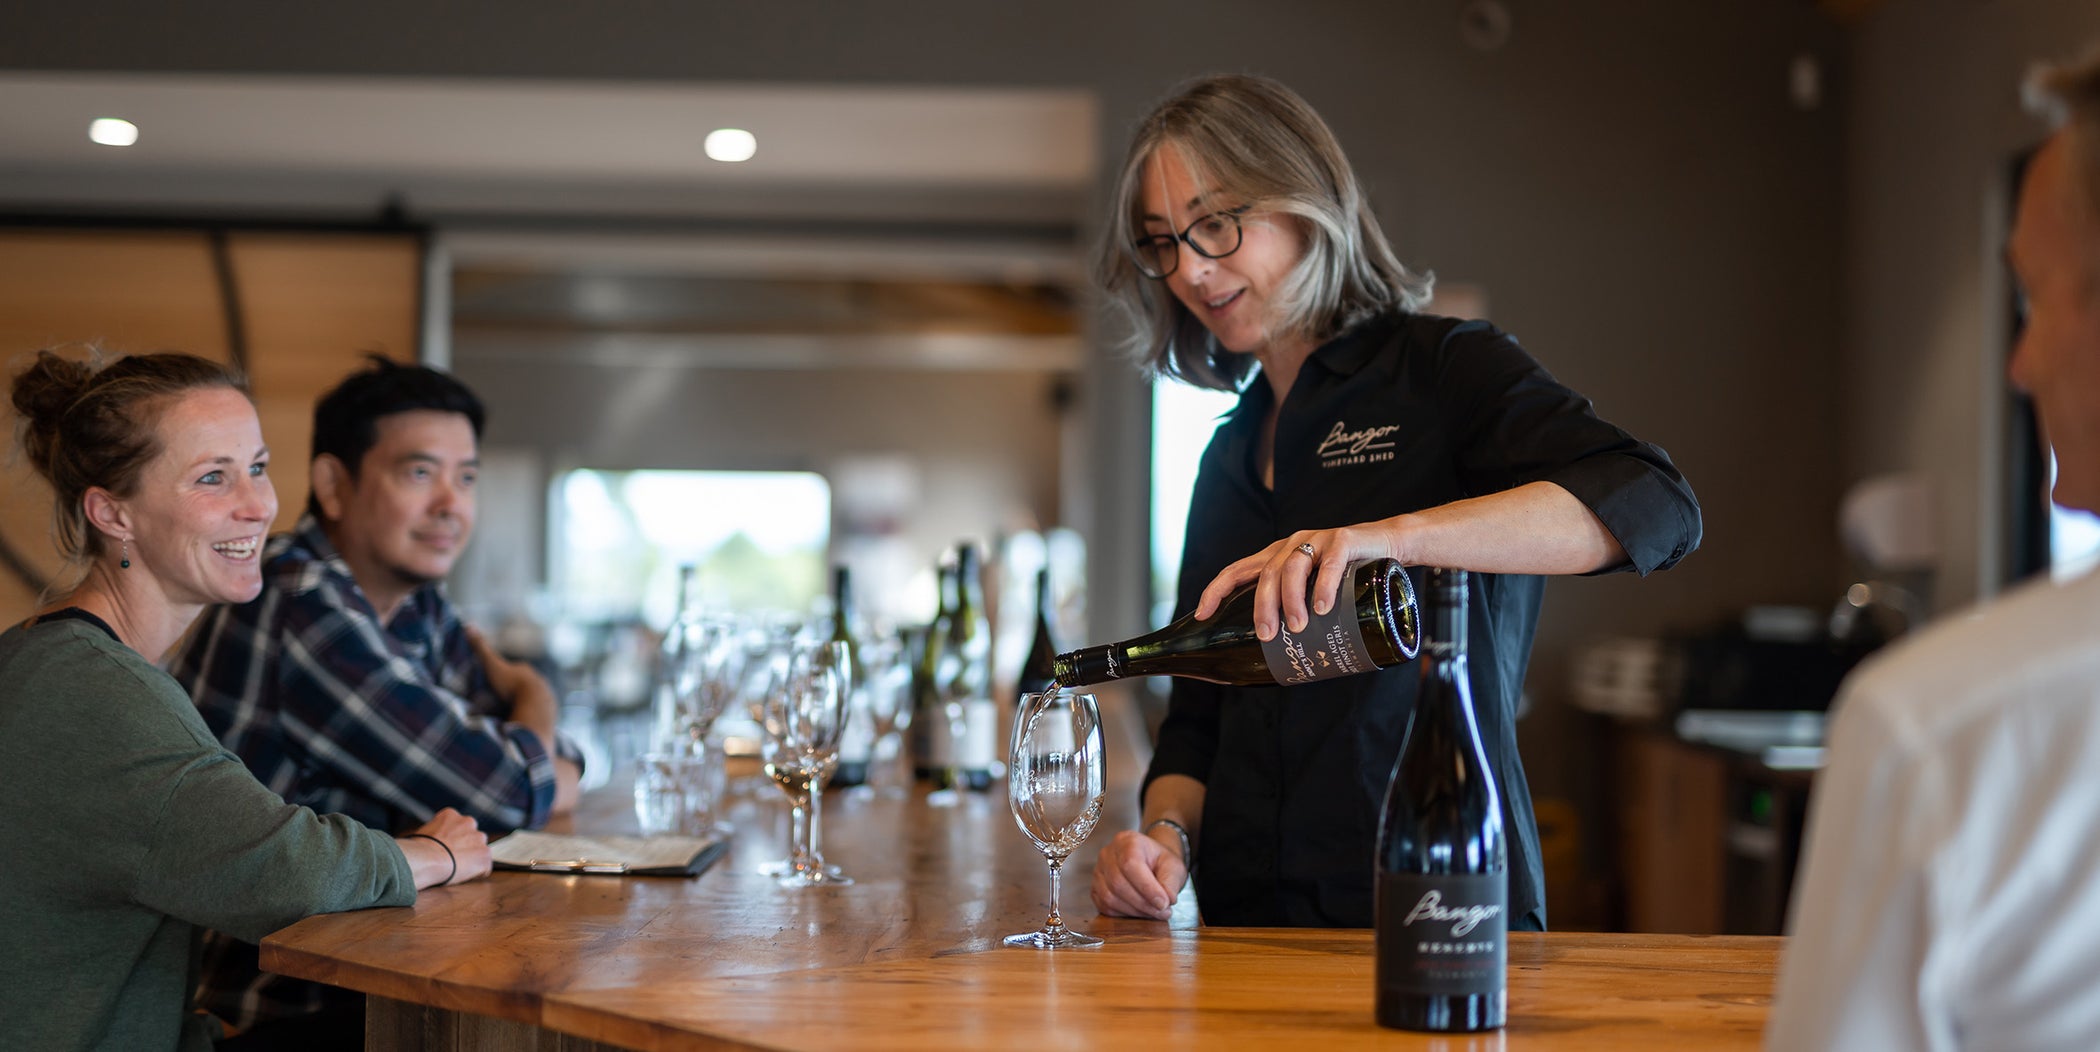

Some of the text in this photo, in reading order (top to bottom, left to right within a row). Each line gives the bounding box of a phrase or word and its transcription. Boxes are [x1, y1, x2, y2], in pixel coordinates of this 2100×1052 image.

[1317, 421, 1400, 455] Bangor
[1322, 451, 1395, 468] VINEYARD SHED
[1326, 633, 1338, 654] AGED
[1333, 625, 1344, 644] GRIS
[1403, 889, 1502, 938] Bangor
